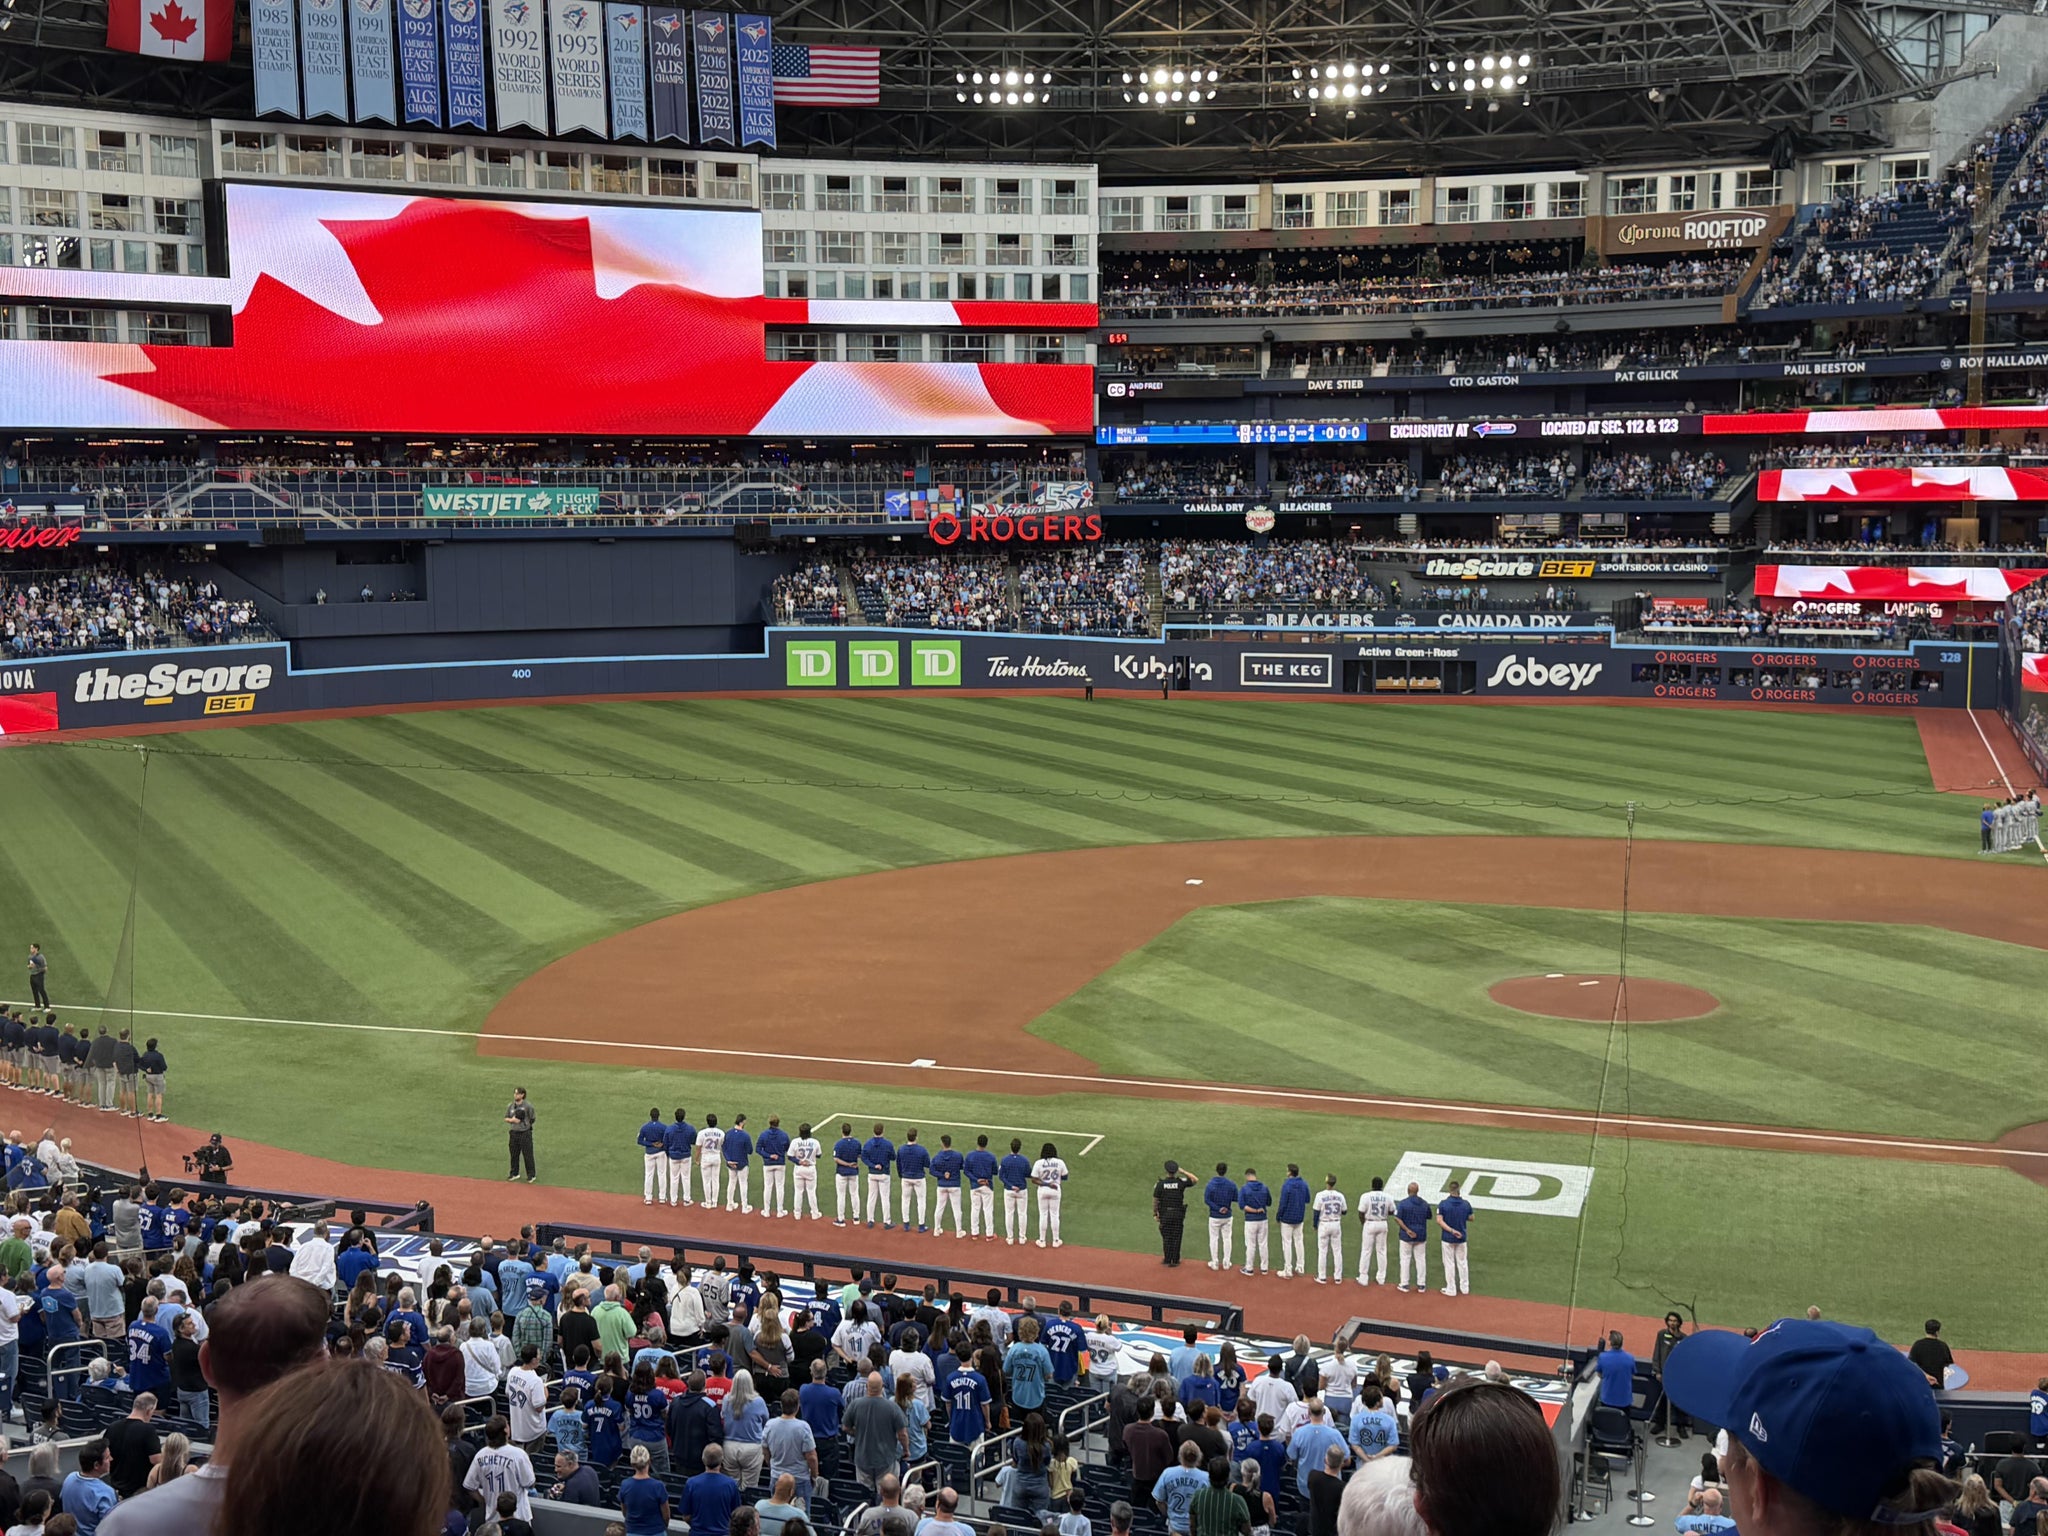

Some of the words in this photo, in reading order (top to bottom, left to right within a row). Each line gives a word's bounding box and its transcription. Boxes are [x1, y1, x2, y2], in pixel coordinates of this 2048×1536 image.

[258, 8, 288, 24] 1985
[308, 13, 338, 28] 1989
[358, 17, 384, 32] 1991
[404, 20, 432, 36] 1992
[257, 28, 290, 37] AMERICAN
[307, 32, 338, 41] AMERICAN
[450, 24, 478, 40] 1993
[257, 36, 290, 48] LEAGUE
[356, 36, 388, 45] AMERICAN
[404, 39, 434, 49] AMERICAN
[498, 28, 538, 50] 1992
[557, 34, 598, 56] 1993
[614, 38, 640, 53] 2015
[307, 40, 340, 52] LEAGUE
[357, 44, 388, 56] LEAGUE
[450, 42, 480, 52] AMERICAN
[655, 42, 681, 57] 2016
[258, 48, 292, 61] EAST
[308, 52, 341, 65] EAST
[404, 48, 434, 59] LEAGUE
[450, 51, 480, 63] LEAGUE
[741, 48, 769, 63] 2025
[258, 62, 292, 72] CHAMPS
[358, 55, 389, 68] EAST
[405, 58, 435, 72] EAST
[498, 53, 541, 69] WORLD
[556, 58, 600, 74] WORLD
[614, 56, 641, 65] AMERICAN
[700, 54, 726, 69] 2016
[308, 65, 341, 75] CHAMPS
[358, 68, 390, 79] CHAMPS
[451, 62, 480, 76] EAST
[614, 65, 641, 76] LEAGUE
[655, 60, 684, 75] ALDS
[743, 66, 770, 75] AMERICAN
[405, 72, 436, 82] CHAMPS
[451, 75, 481, 86] CHAMPS
[498, 68, 542, 84] SERIES
[557, 72, 601, 89] SERIES
[614, 75, 641, 88] EAST
[654, 74, 684, 84] CHAMPS
[700, 74, 728, 89] 2020
[743, 74, 770, 85] LEAGUE
[499, 82, 542, 94] CHAMPIONS
[558, 86, 602, 99] CHAMPIONS
[614, 88, 644, 98] CHAMPS
[743, 84, 770, 97] EAST
[408, 89, 436, 104] ALCS
[454, 92, 482, 107] ALCS
[702, 95, 729, 110] 2022
[743, 97, 771, 107] CHAMPS
[408, 104, 437, 114] CHAMPS
[453, 106, 482, 117] CHAMPS
[617, 104, 644, 118] ALDS
[616, 118, 644, 128] CHAMPS
[703, 114, 730, 130] 2023
[745, 112, 772, 127] ALCS
[745, 126, 773, 137] CHAMPS
[1618, 224, 1680, 246] Corona
[1684, 218, 1766, 240] ROOFTOP
[1706, 238, 1742, 248] PATIO
[1960, 357, 1984, 368] ROY
[1987, 354, 2048, 367] HALLADAY
[1784, 364, 1812, 375] PAUL
[1814, 362, 1865, 374] BEESTON
[1450, 377, 1474, 387] CITO
[1477, 375, 1519, 386] GASTON
[1615, 371, 1636, 382] PAT
[1637, 370, 1679, 381] GILLICK
[1110, 385, 1124, 395] CC
[1308, 380, 1333, 390] DAVE
[1336, 380, 1364, 390] STIEB
[1390, 424, 1453, 439] EXCLUSIVELY
[1455, 424, 1469, 438] AT
[1541, 422, 1586, 436] LOCATED
[1586, 421, 1600, 435] AT
[1602, 420, 1624, 434] SEC.
[1626, 419, 1644, 433] 112
[1646, 420, 1656, 433] &
[1658, 419, 1679, 433] 123
[427, 494, 526, 516] WESTJET
[556, 494, 598, 504] FLIGHT
[1184, 504, 1223, 512] CANADA
[1225, 503, 1244, 512] DRY
[1280, 502, 1332, 512] BLEACHERS
[1246, 515, 1274, 523] CANADA
[970, 514, 1102, 541] ROGERS
[1426, 559, 1533, 576] theScore
[1542, 562, 1591, 574] BET
[1601, 563, 1660, 572] SPORTSBOOK
[1661, 563, 1670, 572] &
[1672, 563, 1708, 572] CASINO
[1809, 603, 1862, 614] ROGERS
[1438, 614, 1520, 628] CANADA
[1530, 615, 1571, 628] DRY
[1358, 647, 1391, 657] Active
[1670, 653, 1717, 663] ROGERS
[1940, 652, 1961, 663] 328
[792, 650, 832, 677] TD
[853, 650, 894, 677] TD
[916, 649, 956, 676] TD
[987, 656, 1018, 677] Tim
[1022, 655, 1087, 677] Hortons
[1767, 655, 1817, 665] ROGERS
[1869, 657, 1920, 668] ROGERS
[512, 669, 531, 679] 400
[1252, 664, 1284, 676] THE
[1290, 664, 1322, 676] KEG
[1488, 654, 1602, 690] Sobeys
[75, 664, 272, 703] theScore
[1669, 687, 1716, 697] ROGERS
[1766, 689, 1816, 700] ROGERS
[1868, 693, 1919, 704] ROGERS
[209, 696, 250, 711] BET
[1042, 1169, 1059, 1180] 26
[1421, 1163, 1563, 1201] TD
[1325, 1203, 1340, 1215] 53
[1371, 1204, 1386, 1216] 51
[164, 1221, 179, 1236] 30
[703, 1284, 718, 1300] 25
[814, 1311, 822, 1327] 4
[848, 1336, 863, 1353] 11
[1050, 1335, 1071, 1352] 27
[129, 1340, 151, 1364] 34
[1090, 1348, 1109, 1364] 29
[1016, 1363, 1036, 1382] 27
[565, 1376, 591, 1390] SPRINGER
[950, 1377, 977, 1390] BICHETTE
[509, 1386, 527, 1409] 29
[635, 1394, 648, 1403] KIRK
[954, 1391, 971, 1410] 11
[633, 1404, 652, 1419] 30
[2031, 1401, 2044, 1414] 19
[594, 1417, 604, 1432] 7
[1362, 1417, 1383, 1426] CEASE
[559, 1430, 580, 1444] 22
[1360, 1428, 1386, 1446] 84
[477, 1455, 514, 1469] BICHETTE
[485, 1470, 505, 1492] 11
